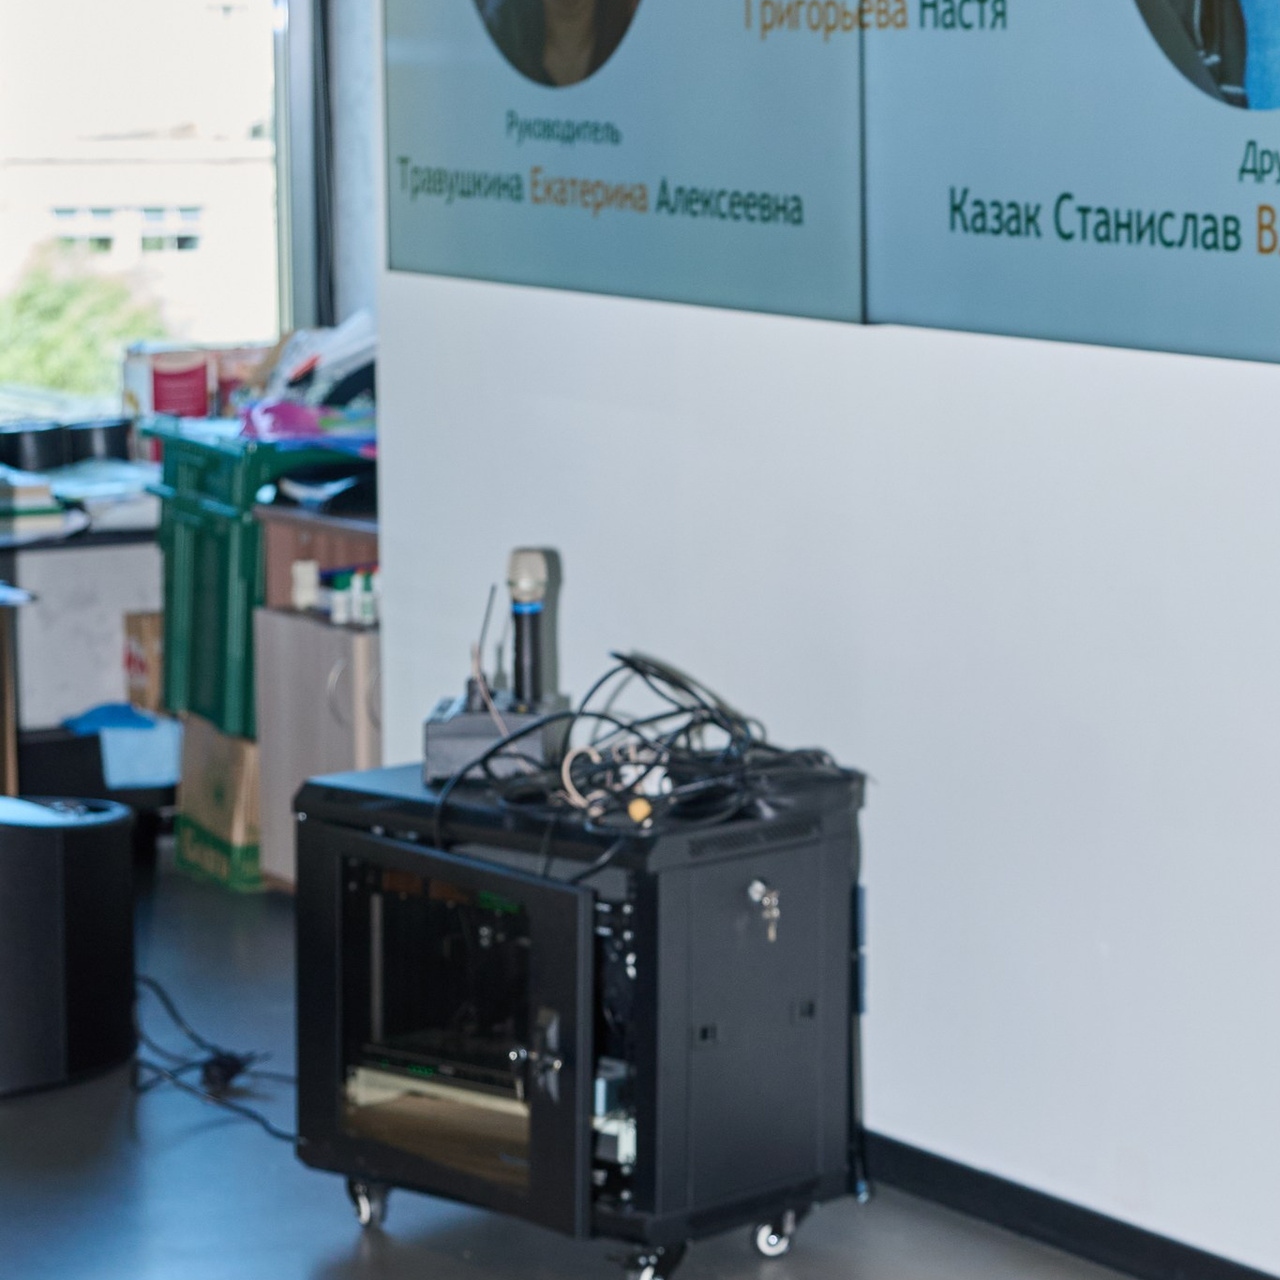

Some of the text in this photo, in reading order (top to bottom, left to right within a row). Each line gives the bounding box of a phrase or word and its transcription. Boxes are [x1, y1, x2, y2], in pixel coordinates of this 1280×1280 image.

[505, 109, 624, 146] Руководитель
[397, 155, 805, 226] Травушкина Екатерина Алексеевна
[948, 184, 1043, 240] Казак
[1052, 191, 1243, 253] Станислав
